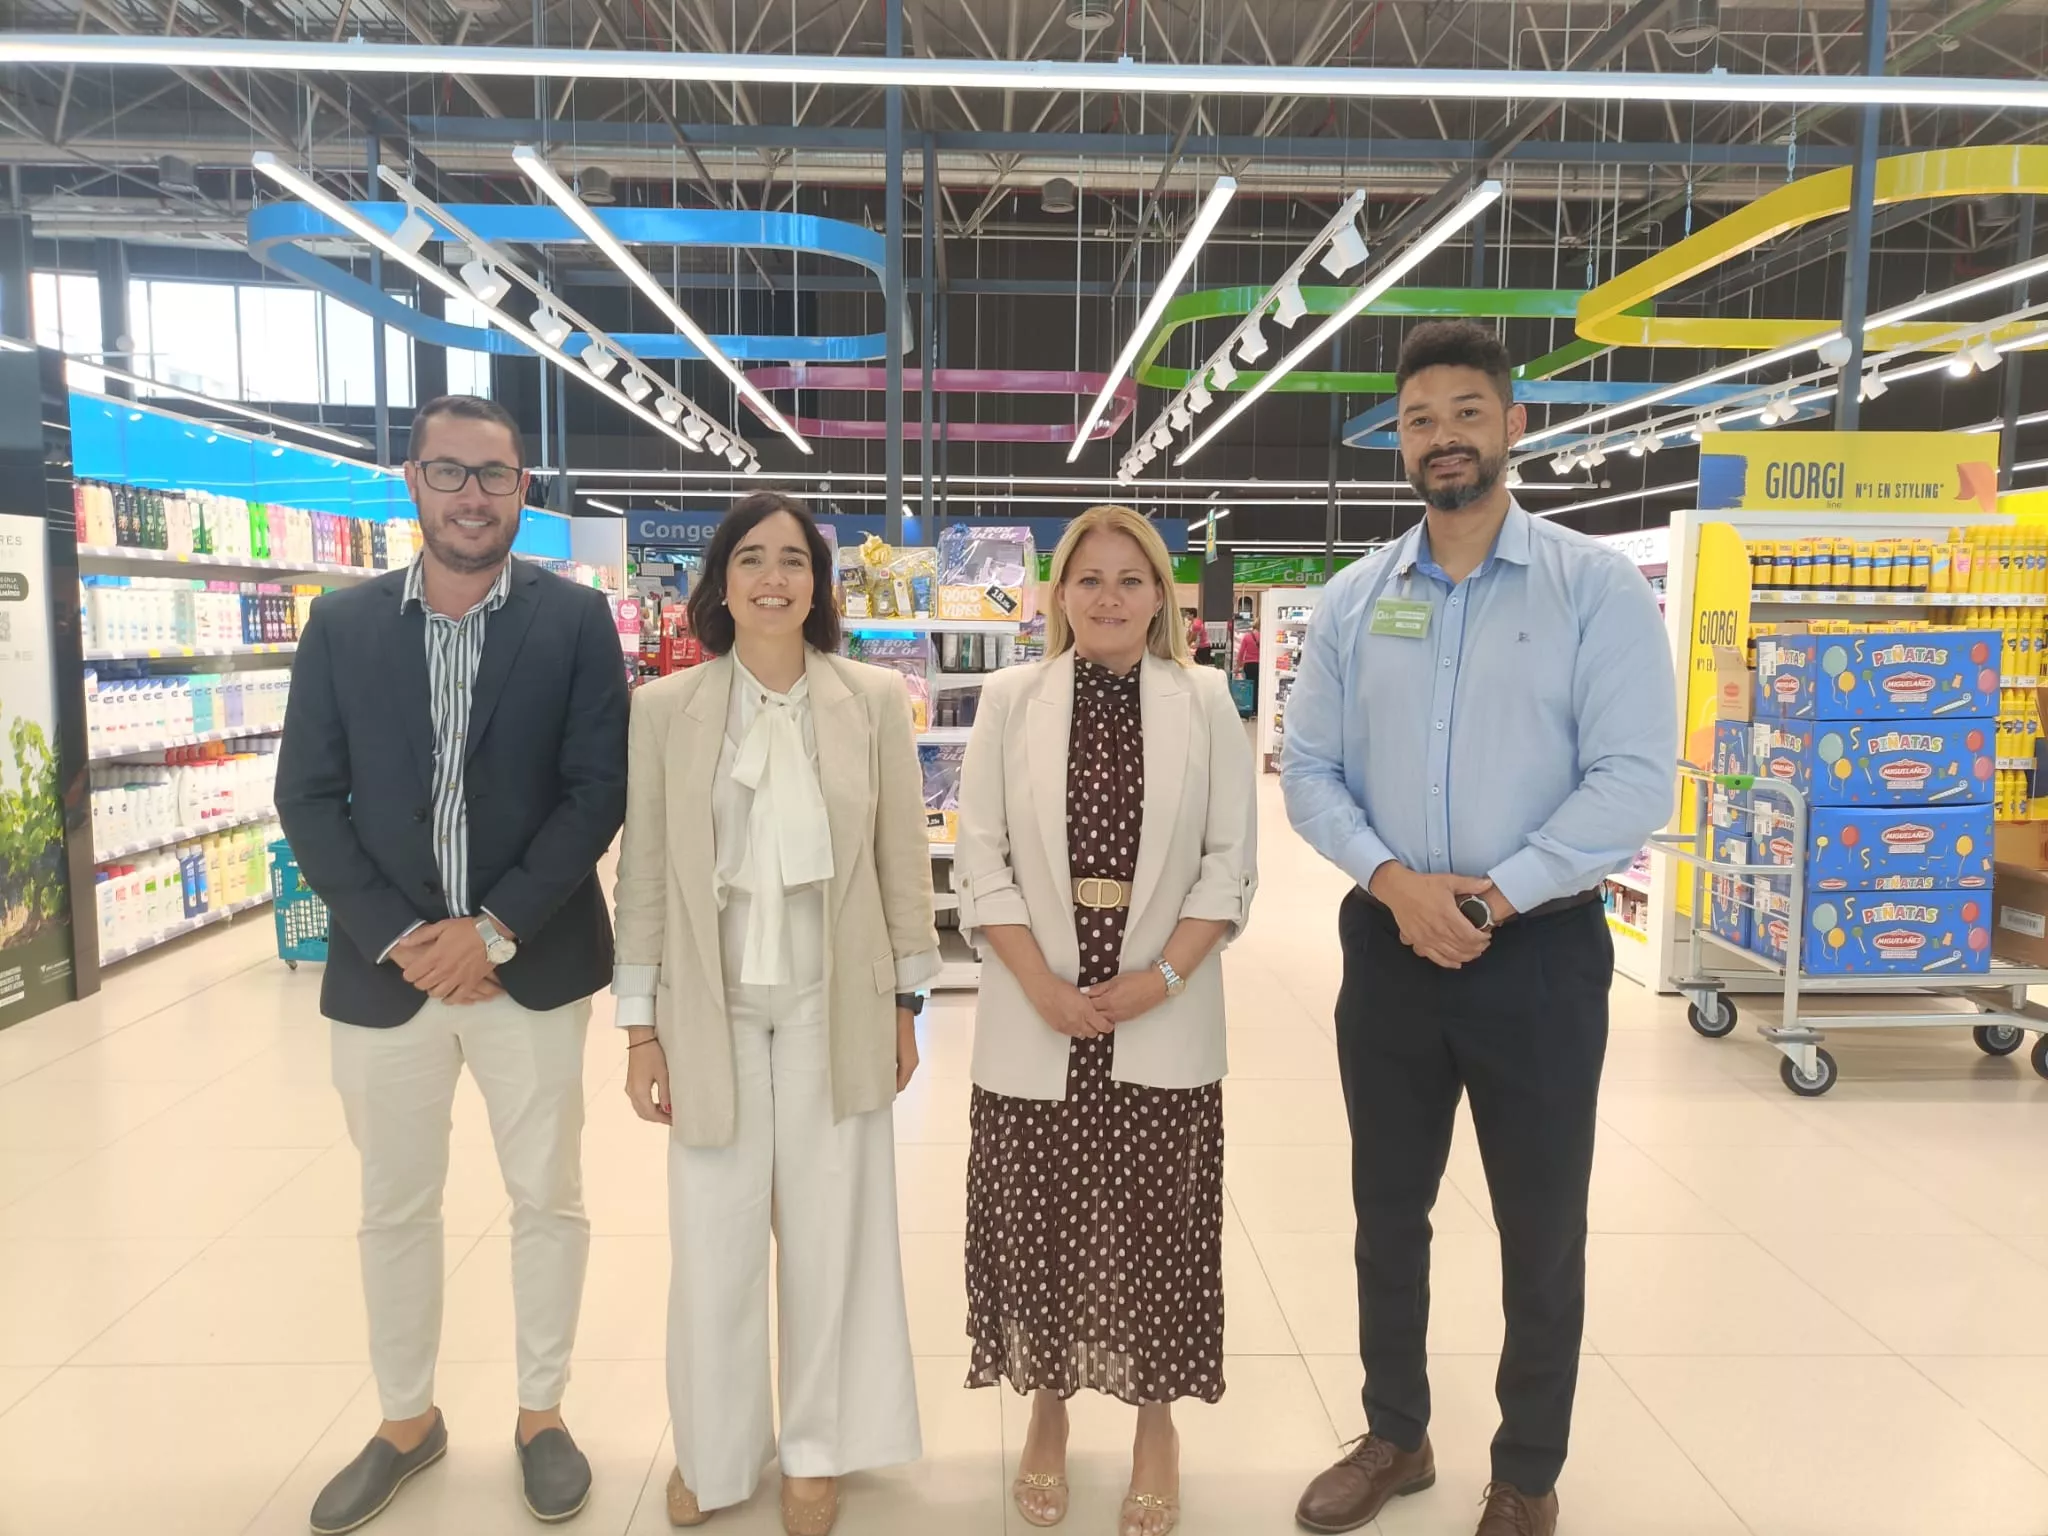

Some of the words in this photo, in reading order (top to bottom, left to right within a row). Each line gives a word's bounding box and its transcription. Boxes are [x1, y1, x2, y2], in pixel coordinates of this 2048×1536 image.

[1766, 461, 1845, 499] GIORGI
[1878, 483, 1891, 499] EN
[1826, 500, 1842, 509] line
[640, 520, 719, 542] Conge
[1699, 610, 1738, 645] GIORGI
[884, 640, 913, 648] BOX
[901, 647, 920, 656] OF
[1872, 644, 1948, 667] PIÑATAS
[1886, 678, 1933, 689] MIGUELAÑEZ
[1868, 732, 1944, 755] PIÑATAS
[1883, 765, 1928, 775] MIGUELAÑEZ
[1886, 830, 1931, 840] MIGUELAÑEZ
[1875, 874, 1934, 889] PIÑATAS
[1862, 902, 1939, 925] PIÑATAS
[1877, 935, 1923, 945] MIGUELAÑEZ
